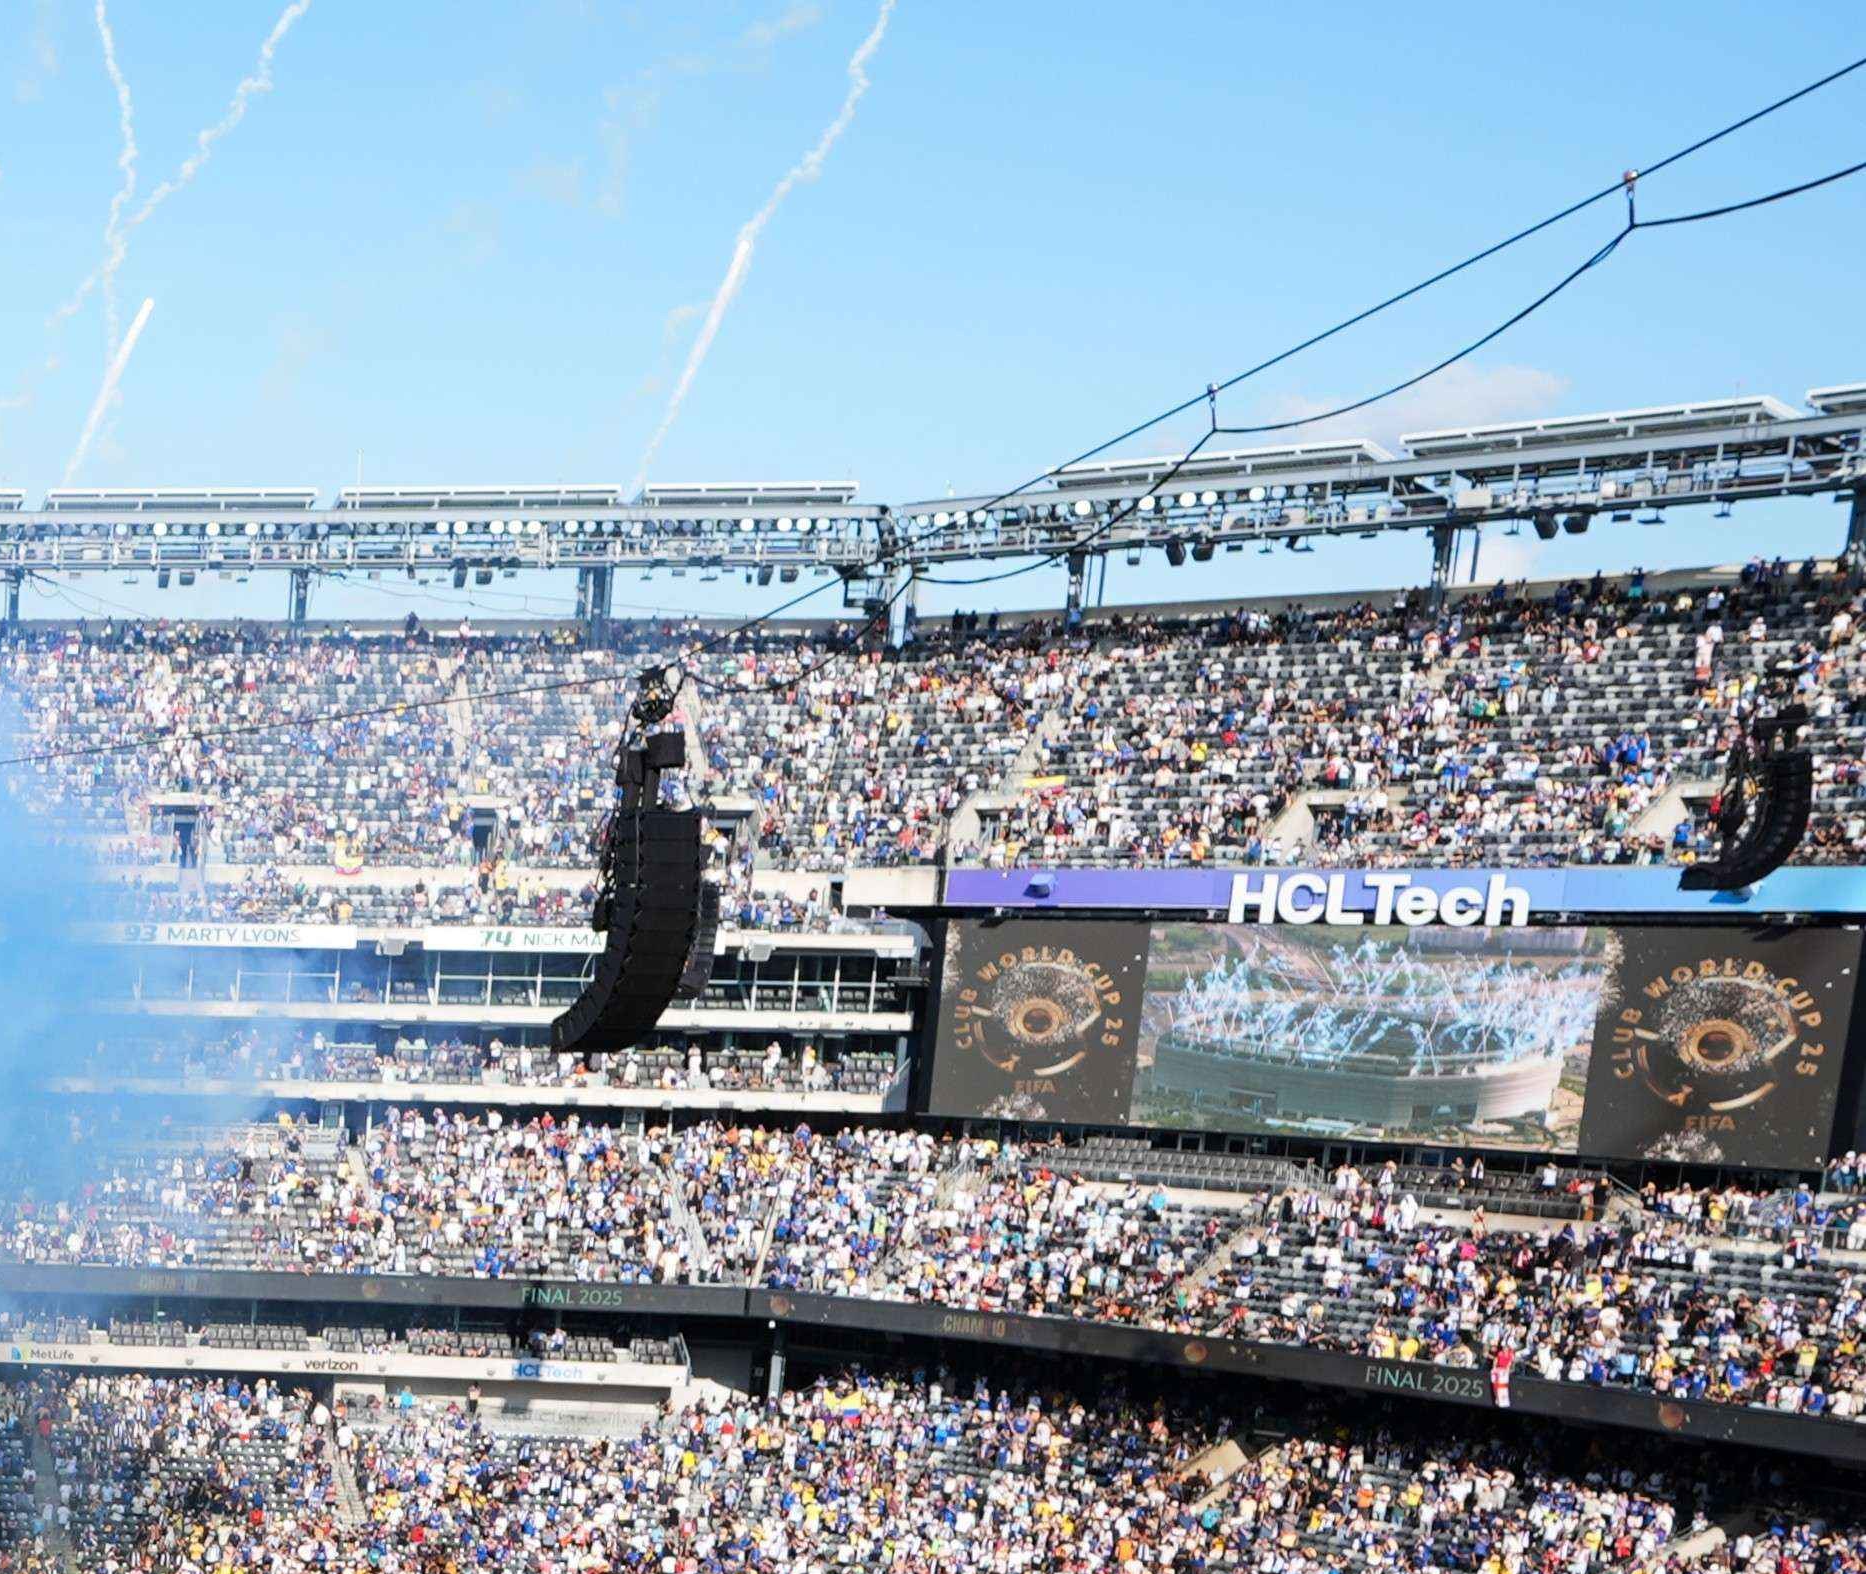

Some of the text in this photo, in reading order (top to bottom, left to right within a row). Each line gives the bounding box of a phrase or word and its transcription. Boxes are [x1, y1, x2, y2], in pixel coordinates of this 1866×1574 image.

[1228, 873, 1531, 926] HCLTech
[168, 927, 238, 942] MARTY
[242, 927, 301, 942] LYONS
[523, 932, 565, 946] NICK
[1685, 1115, 1736, 1131] FIFA
[521, 1287, 622, 1306] FINAL 2025
[30, 1350, 75, 1361] MetLife
[303, 1358, 359, 1372] verizon
[1365, 1365, 1484, 1398] FINAL 2025
